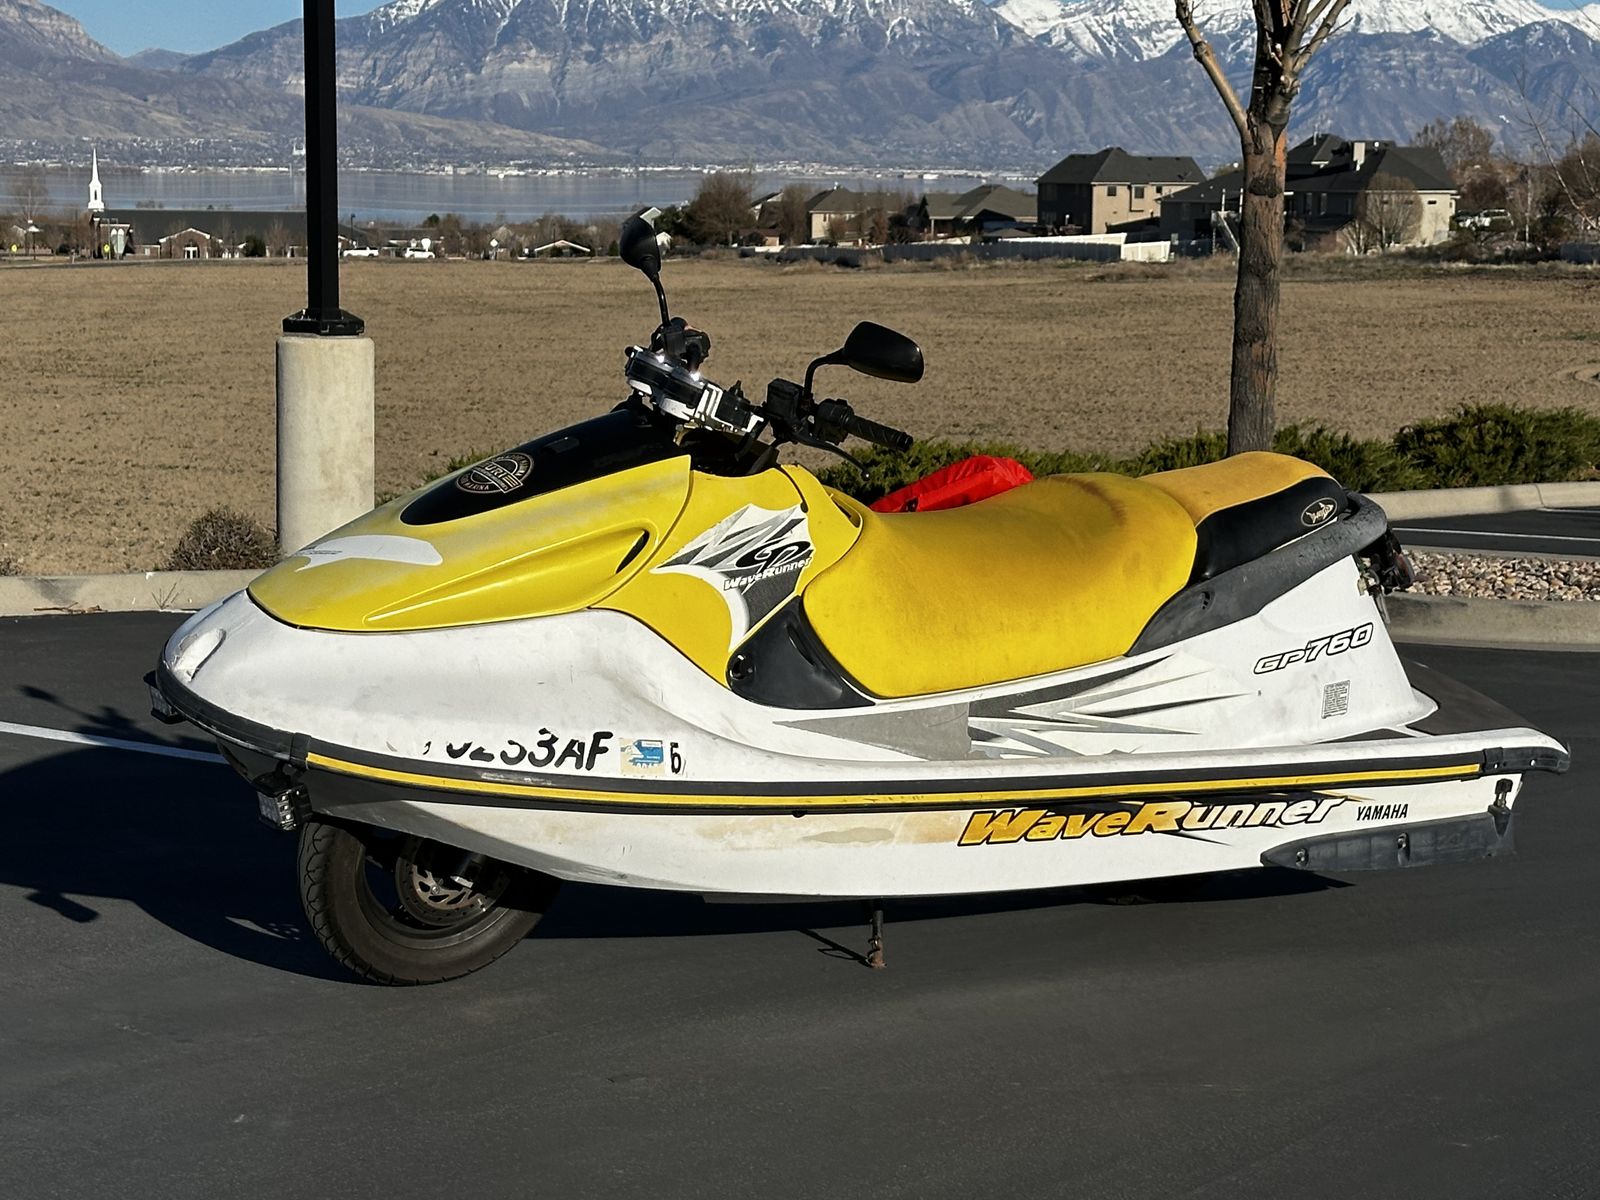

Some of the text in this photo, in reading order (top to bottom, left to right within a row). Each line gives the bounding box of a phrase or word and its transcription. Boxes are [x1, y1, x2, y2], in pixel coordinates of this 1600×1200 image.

[723, 556, 812, 591] WaveRunner
[1254, 622, 1373, 674] GP760
[957, 797, 1348, 846] WaveRunner
[1356, 803, 1409, 821] YAMAHA
